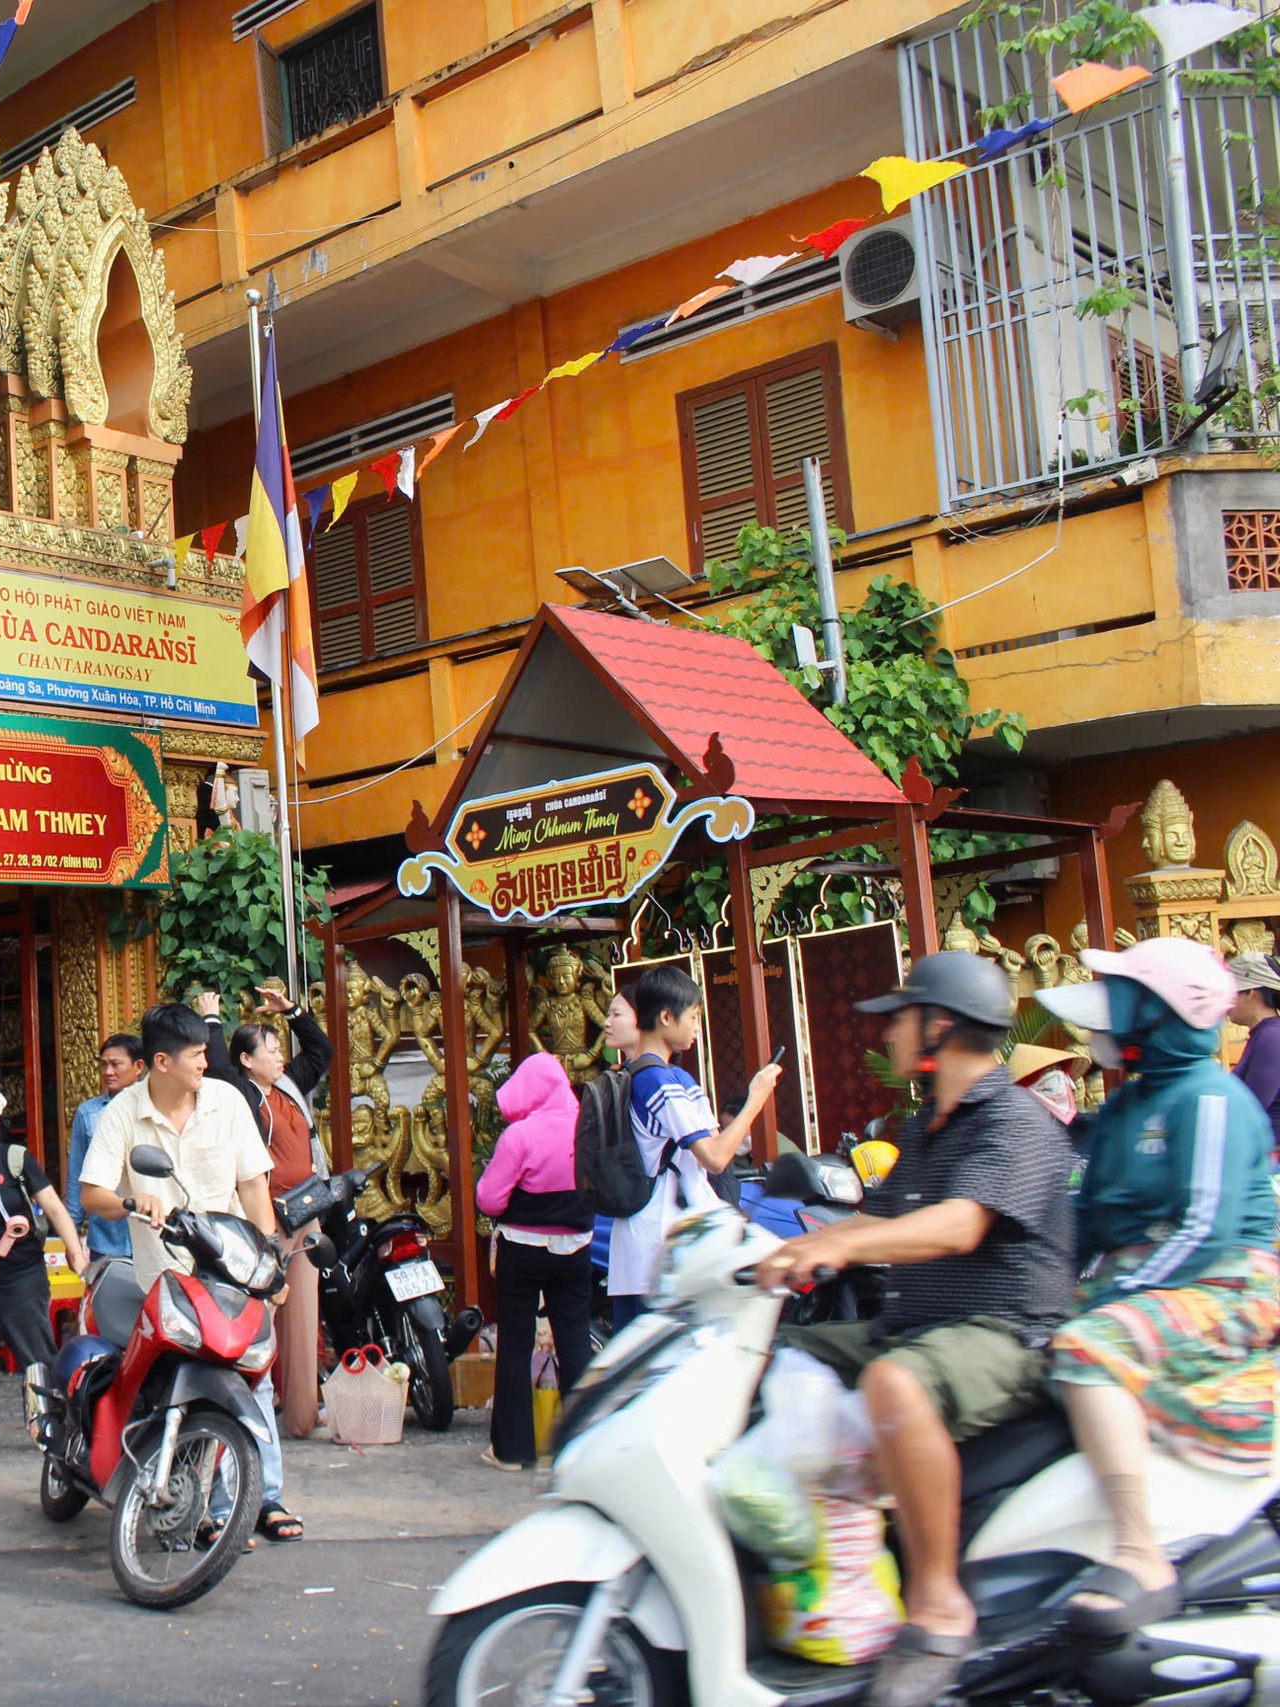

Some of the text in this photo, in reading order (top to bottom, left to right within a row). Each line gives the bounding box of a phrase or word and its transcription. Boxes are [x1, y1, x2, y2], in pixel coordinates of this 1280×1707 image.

[14, 587, 40, 607] HỘI
[43, 591, 82, 613] PHẬT
[86, 597, 120, 620] GIÁO
[123, 602, 154, 626] VIỆT
[157, 611, 186, 629] NAM
[18, 652, 153, 683] CHANTARANGSAY
[28, 681, 44, 696] Sa,
[47, 683, 89, 702] Phường
[91, 688, 117, 704] Xuân
[119, 692, 141, 708] Hòa,
[143, 695, 158, 708] TP.
[161, 696, 174, 710] Hồ
[176, 699, 192, 712] Chí
[194, 701, 216, 715] Minh
[545, 799, 563, 812] CHÙA
[34, 810, 107, 837] THMEY
[534, 815, 583, 844] Chhnam
[583, 807, 620, 836] Thmey
[3, 855, 16, 867] 27,
[18, 855, 30, 867] 28,
[31, 855, 42, 867] 29
[43, 855, 58, 867] /02
[59, 854, 81, 868] /BÍNH
[82, 857, 97, 871] NGỌ
[393, 1266, 429, 1285] 59-FA
